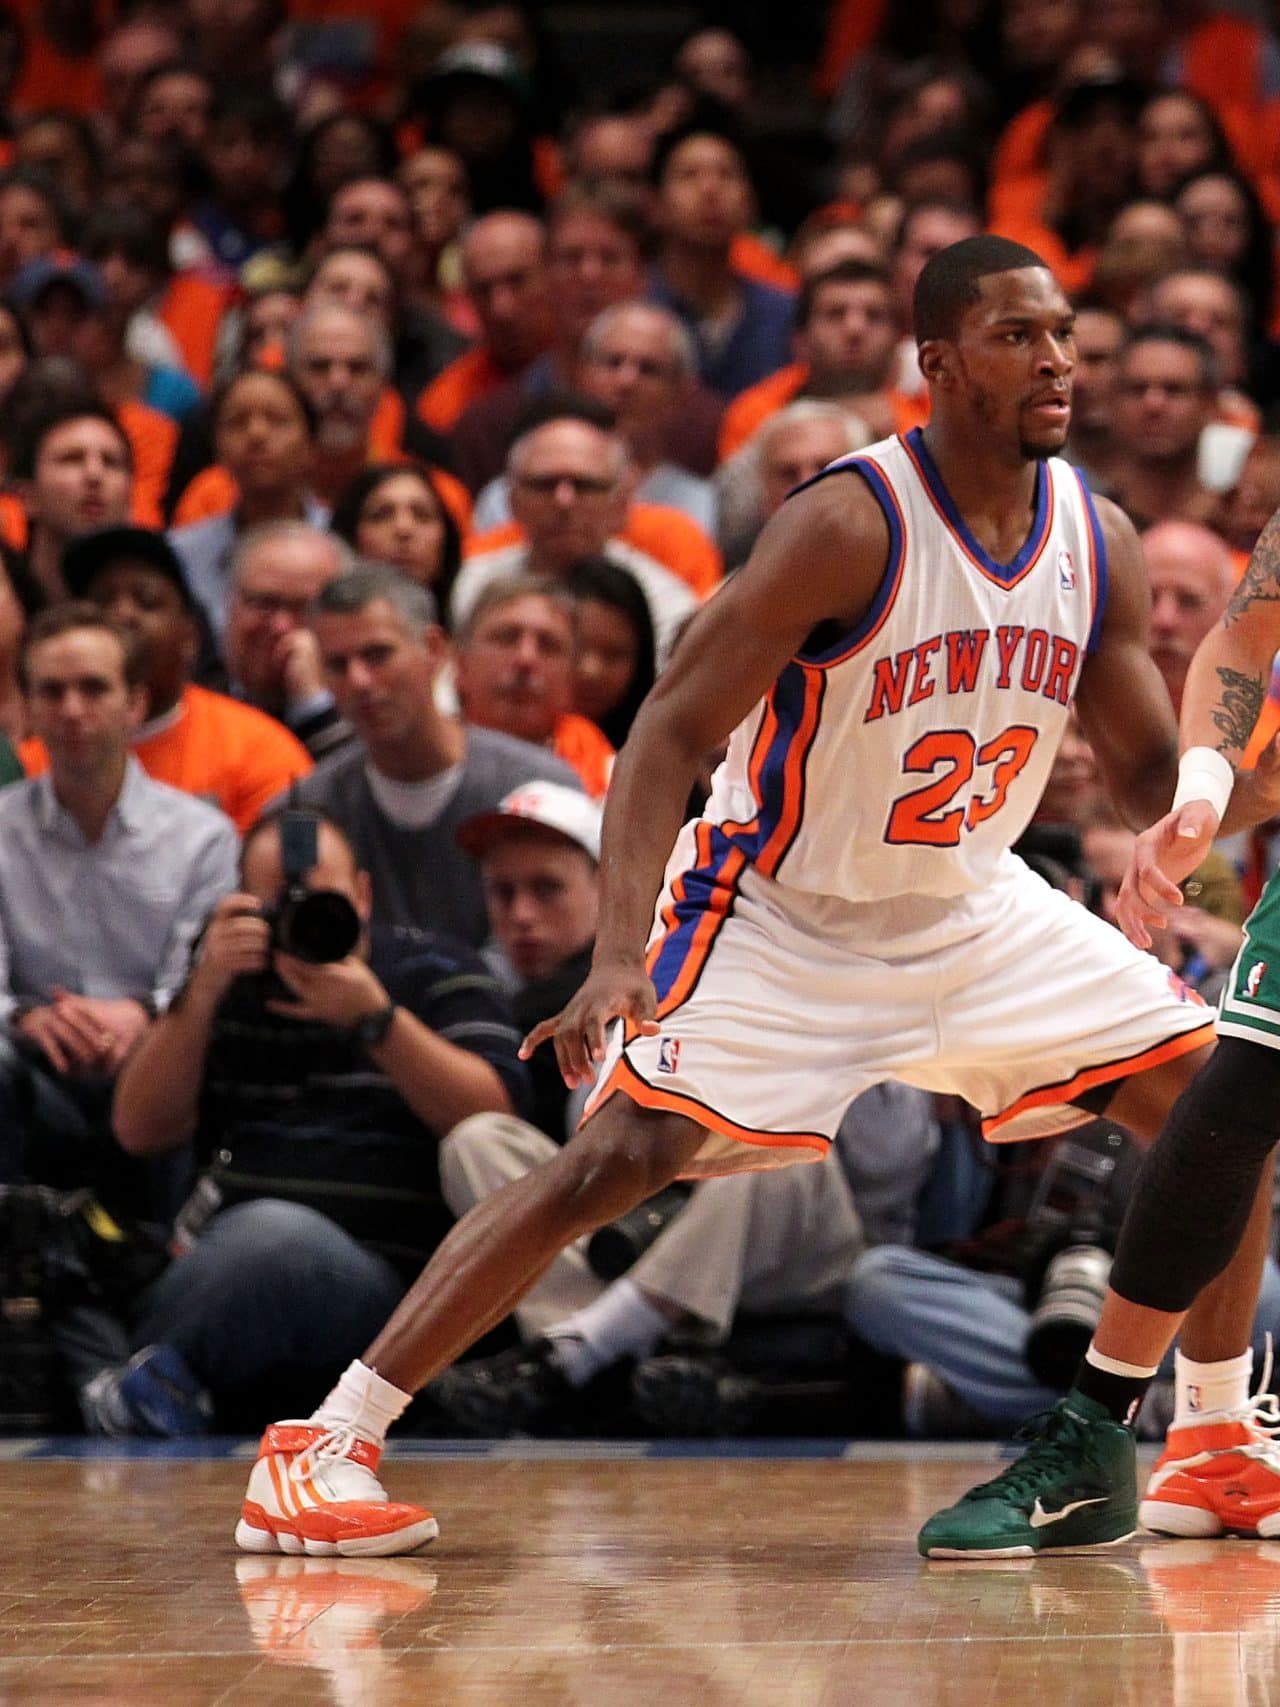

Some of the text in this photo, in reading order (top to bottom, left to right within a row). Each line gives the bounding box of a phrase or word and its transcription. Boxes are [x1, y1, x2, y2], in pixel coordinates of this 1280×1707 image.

[863, 625, 1087, 724] NEW YOR
[883, 725, 1039, 847] 23
